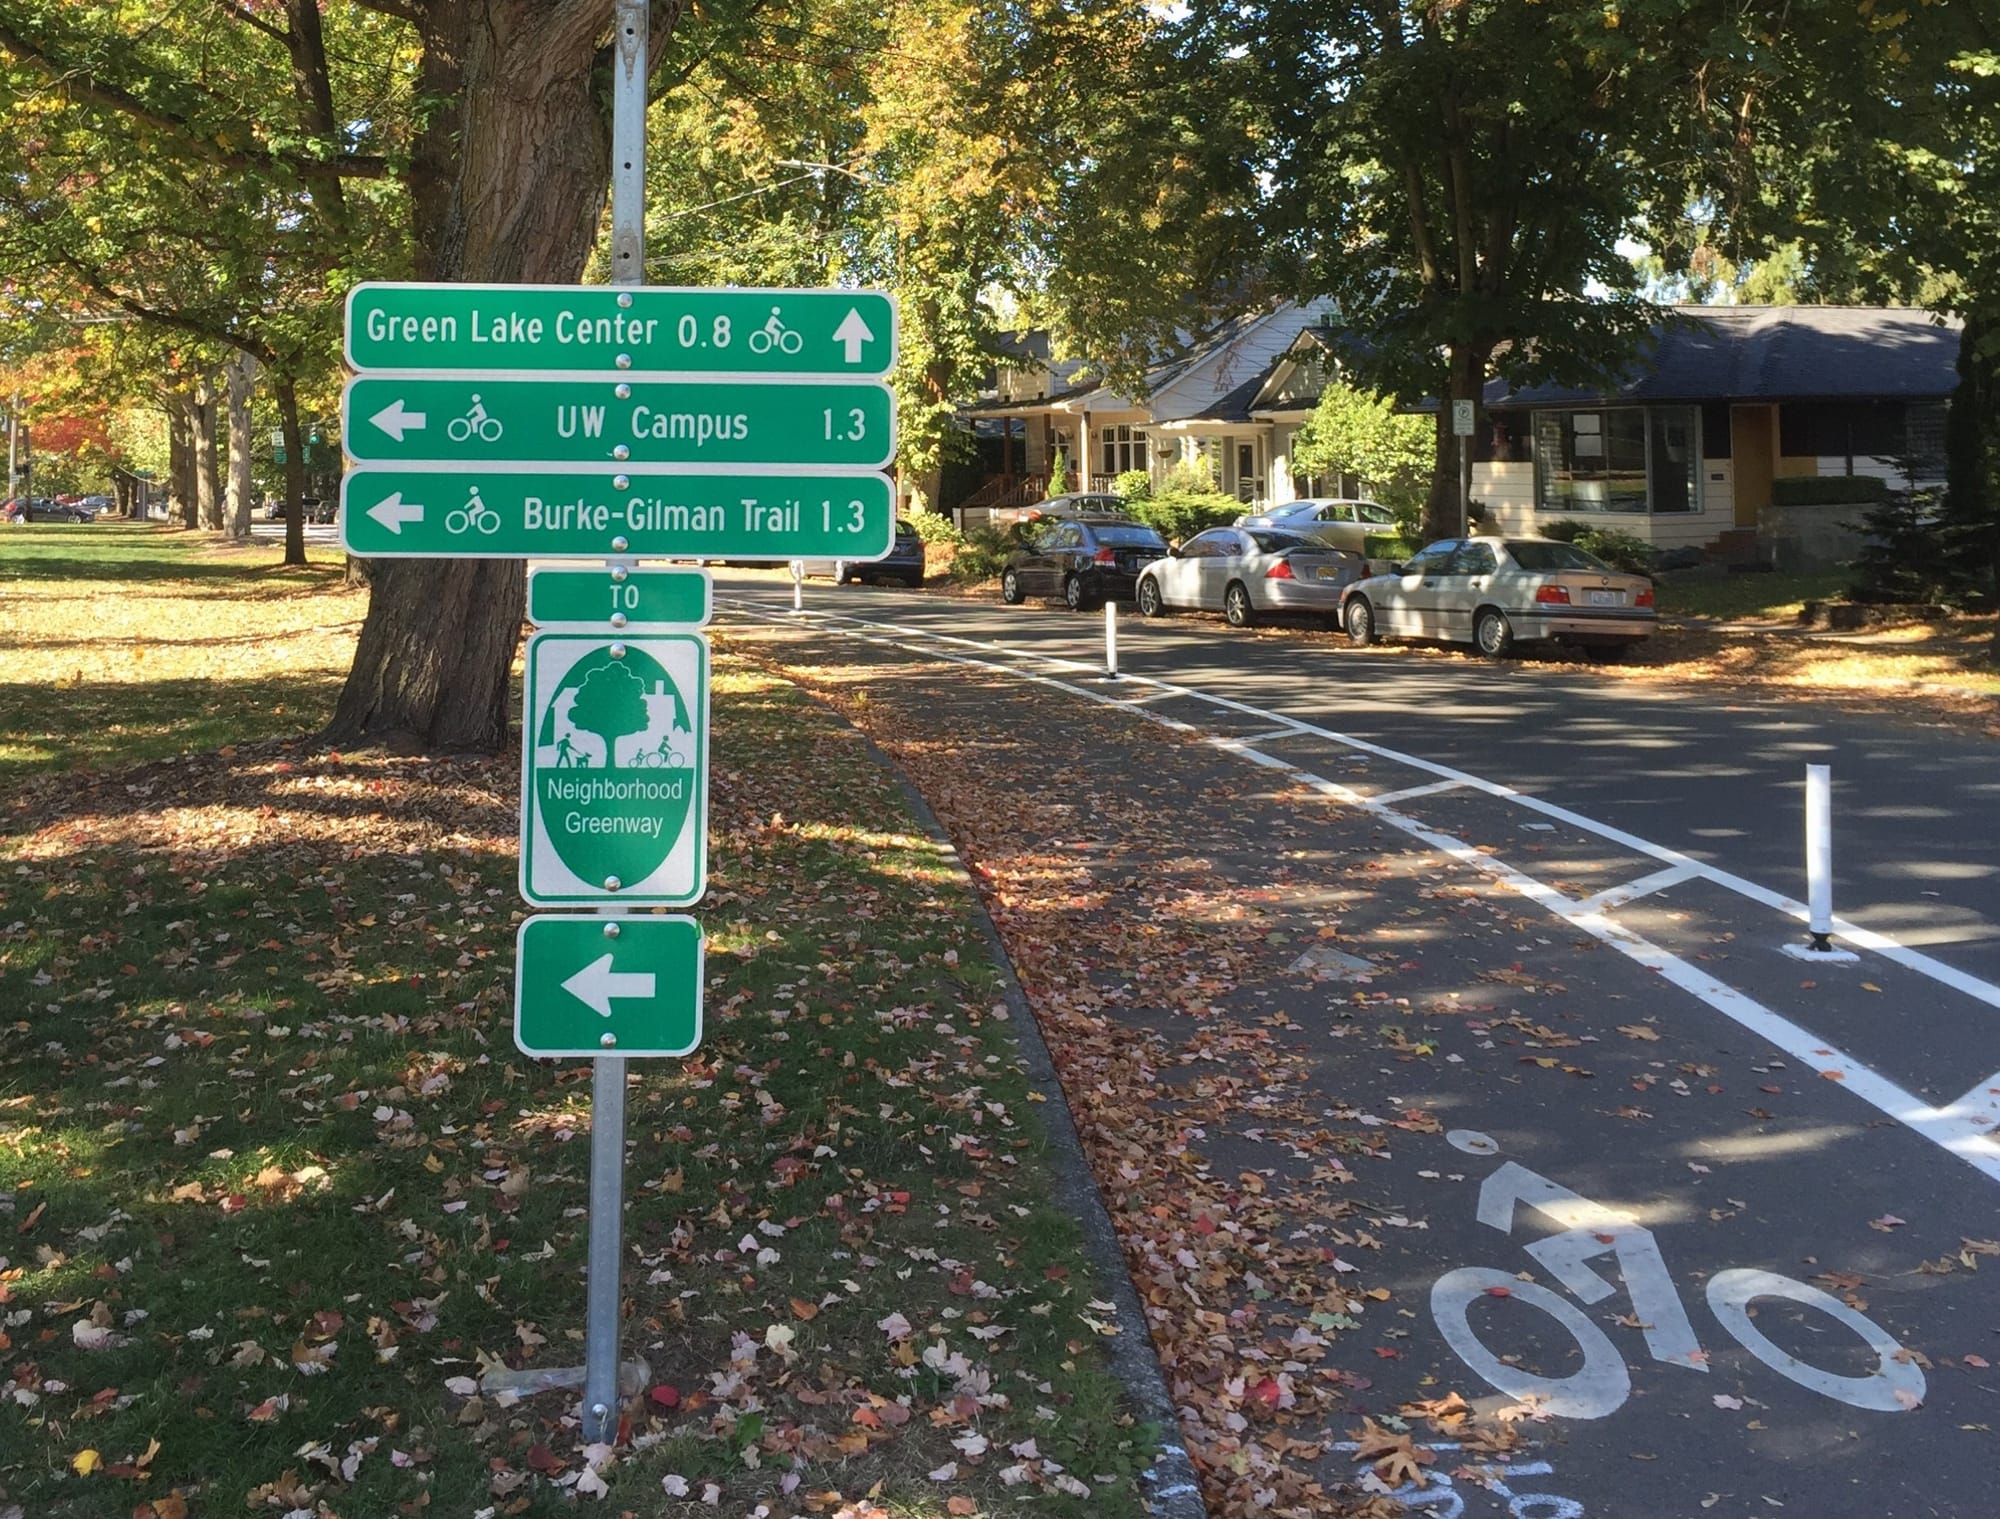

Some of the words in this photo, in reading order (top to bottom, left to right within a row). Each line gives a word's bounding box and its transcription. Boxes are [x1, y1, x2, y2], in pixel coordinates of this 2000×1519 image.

[367, 308, 457, 342] Green
[471, 310, 543, 344] Lake
[555, 310, 658, 345] Center
[678, 314, 731, 348] 0.8
[557, 405, 605, 438] UW
[631, 405, 748, 447] Campus
[823, 408, 866, 441] 1.3
[524, 497, 725, 531] Burke-Gilman
[741, 499, 800, 532] Trail
[822, 500, 865, 533] 1.3
[609, 584, 639, 609] TO
[547, 778, 682, 805] Neighborhood
[565, 811, 664, 839] Greenway
